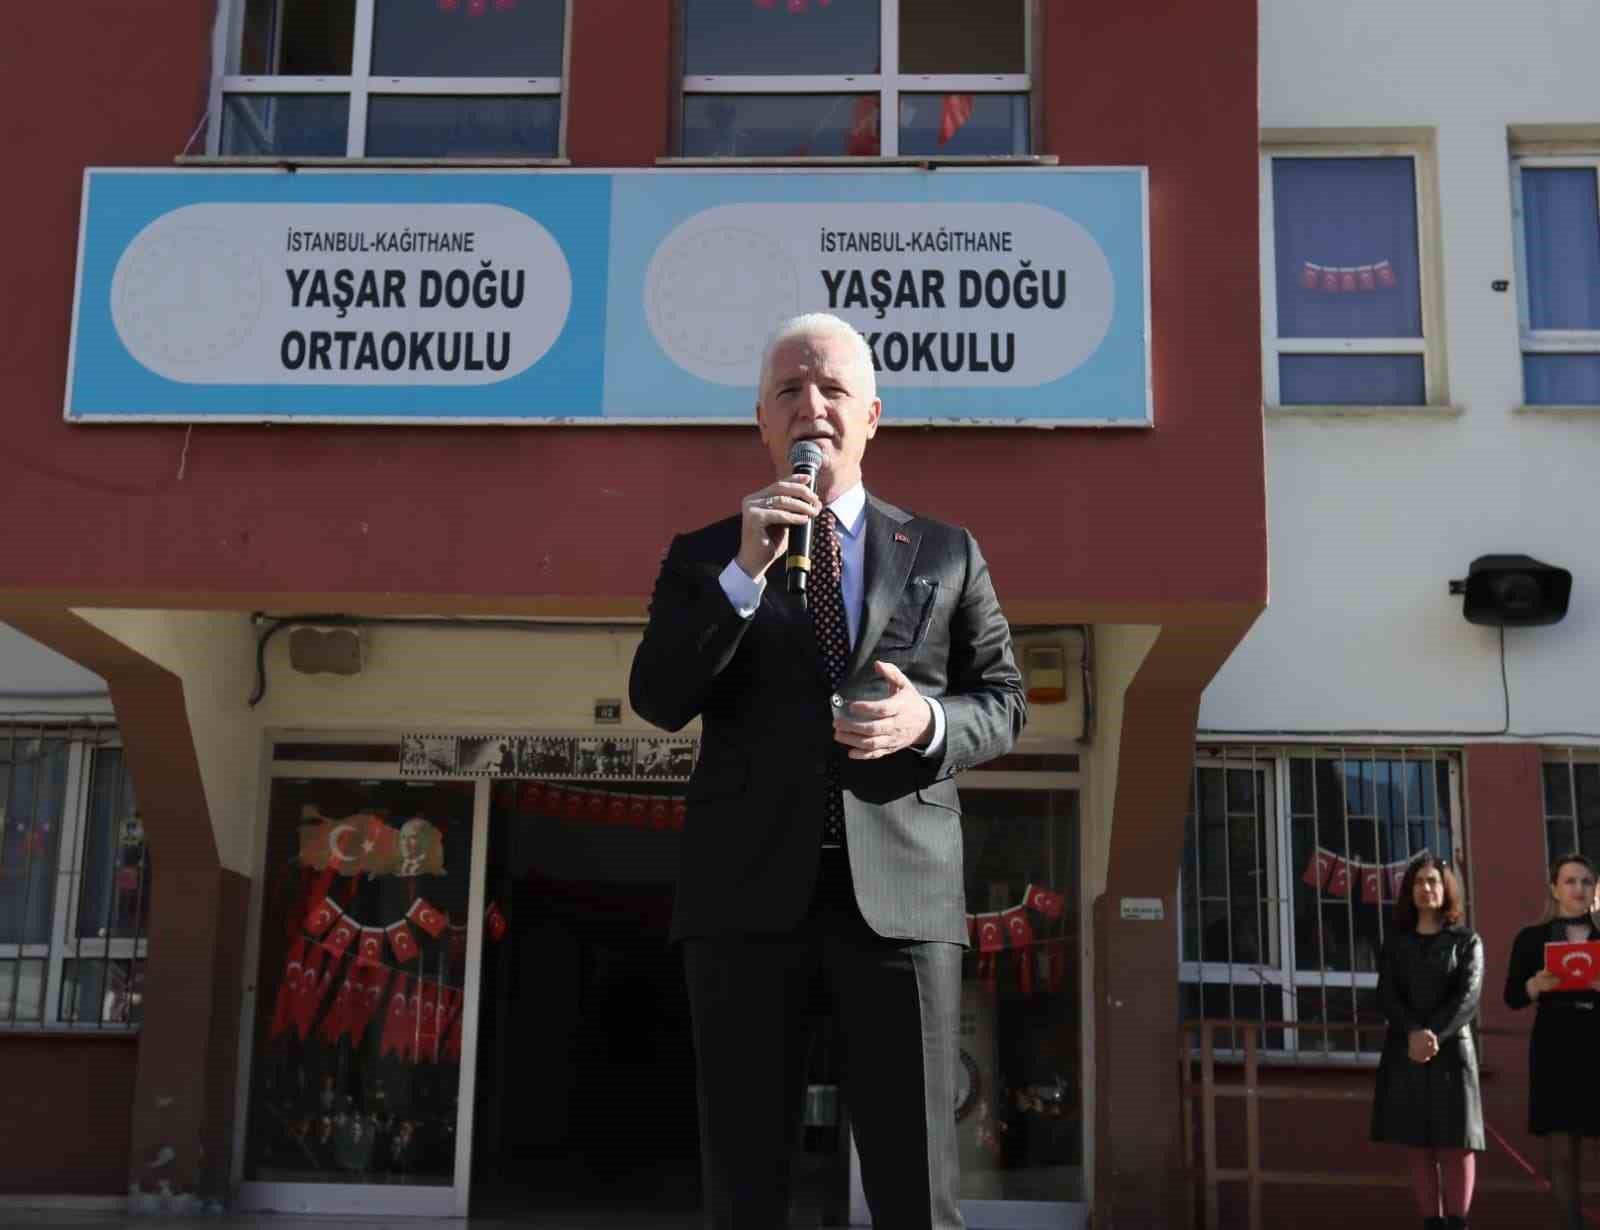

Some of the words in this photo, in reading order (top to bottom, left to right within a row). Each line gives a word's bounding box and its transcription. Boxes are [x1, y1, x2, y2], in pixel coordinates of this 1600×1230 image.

[287, 226, 475, 253] İSTANBUL-KAĞITHANE
[820, 227, 1013, 253] İSTANBUL-KAĞITHANE
[285, 268, 407, 319] YAŞAR
[419, 259, 525, 309] DOĞU
[820, 268, 946, 320] YAŞAR
[959, 259, 1067, 310] DOĞU
[280, 330, 511, 372] ORTAOKULU
